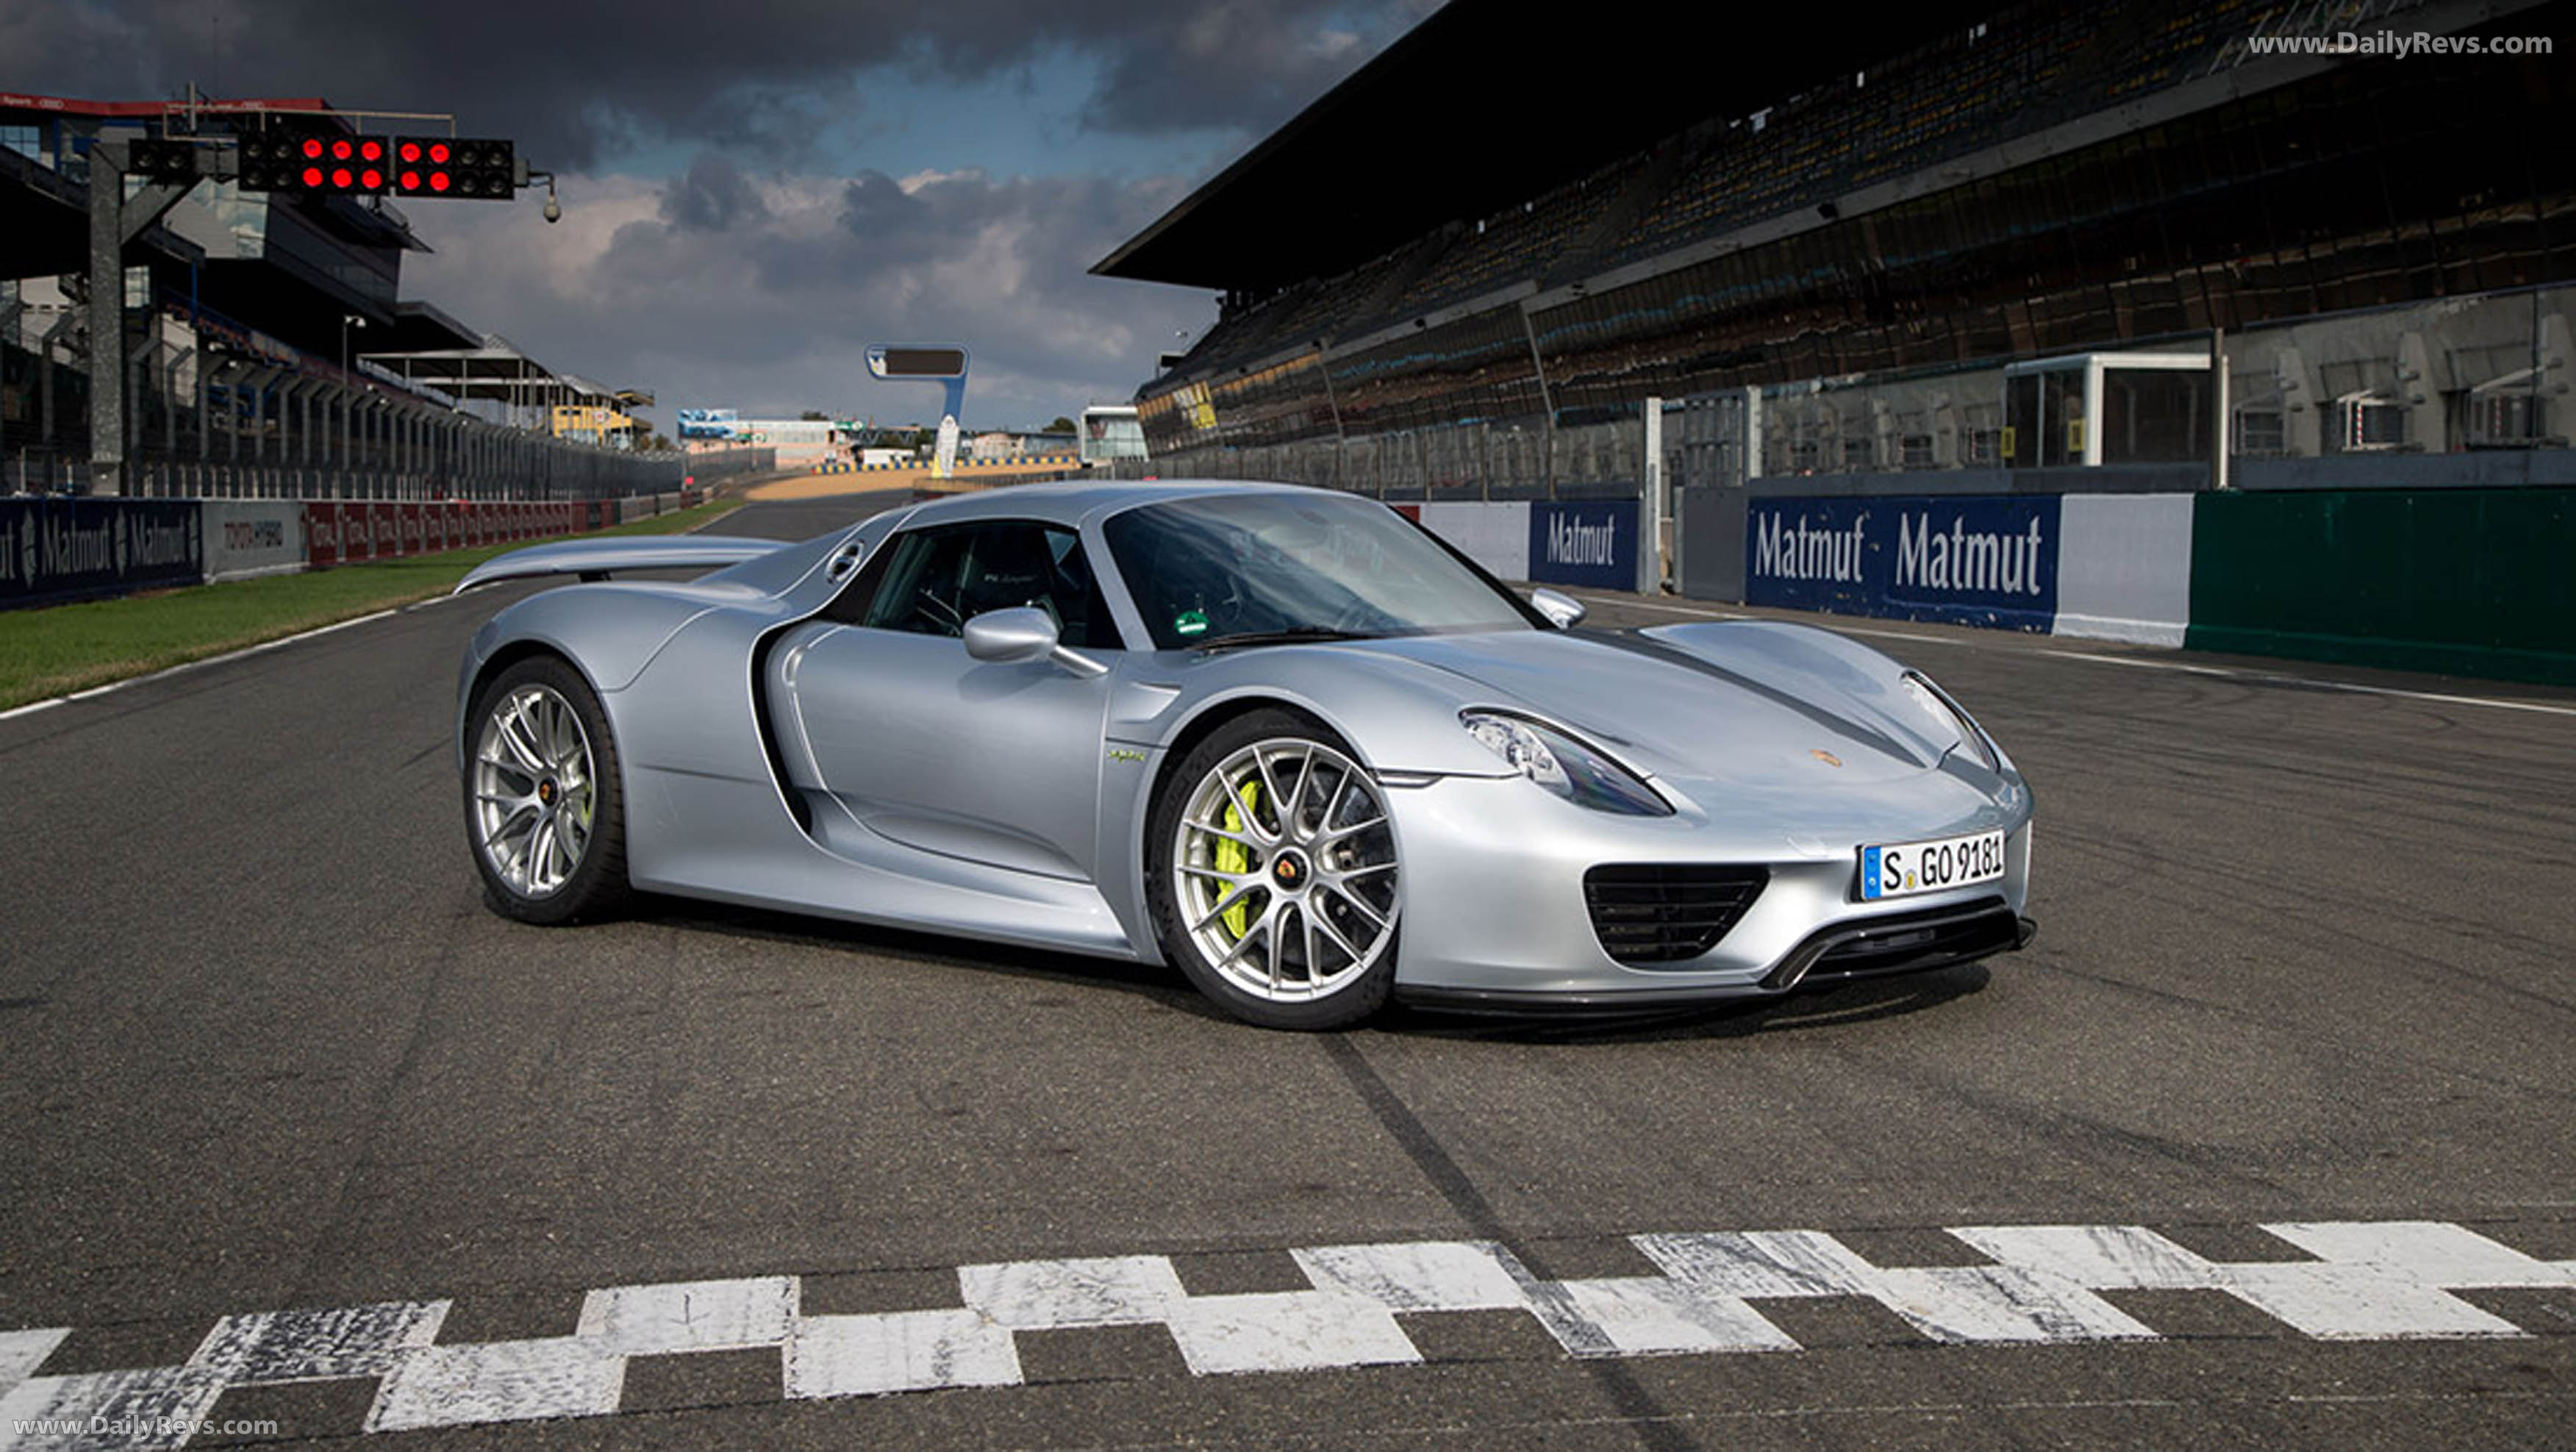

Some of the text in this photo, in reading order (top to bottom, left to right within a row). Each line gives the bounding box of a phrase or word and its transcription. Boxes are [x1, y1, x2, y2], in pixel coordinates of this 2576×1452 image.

[41, 515, 112, 576] Matmut
[131, 514, 185, 568] Matmut
[1547, 511, 1615, 566] Matmut
[1756, 512, 1864, 582] Matmut
[1896, 512, 2042, 596] Matmut
[1884, 836, 2002, 890] S GO 9181
